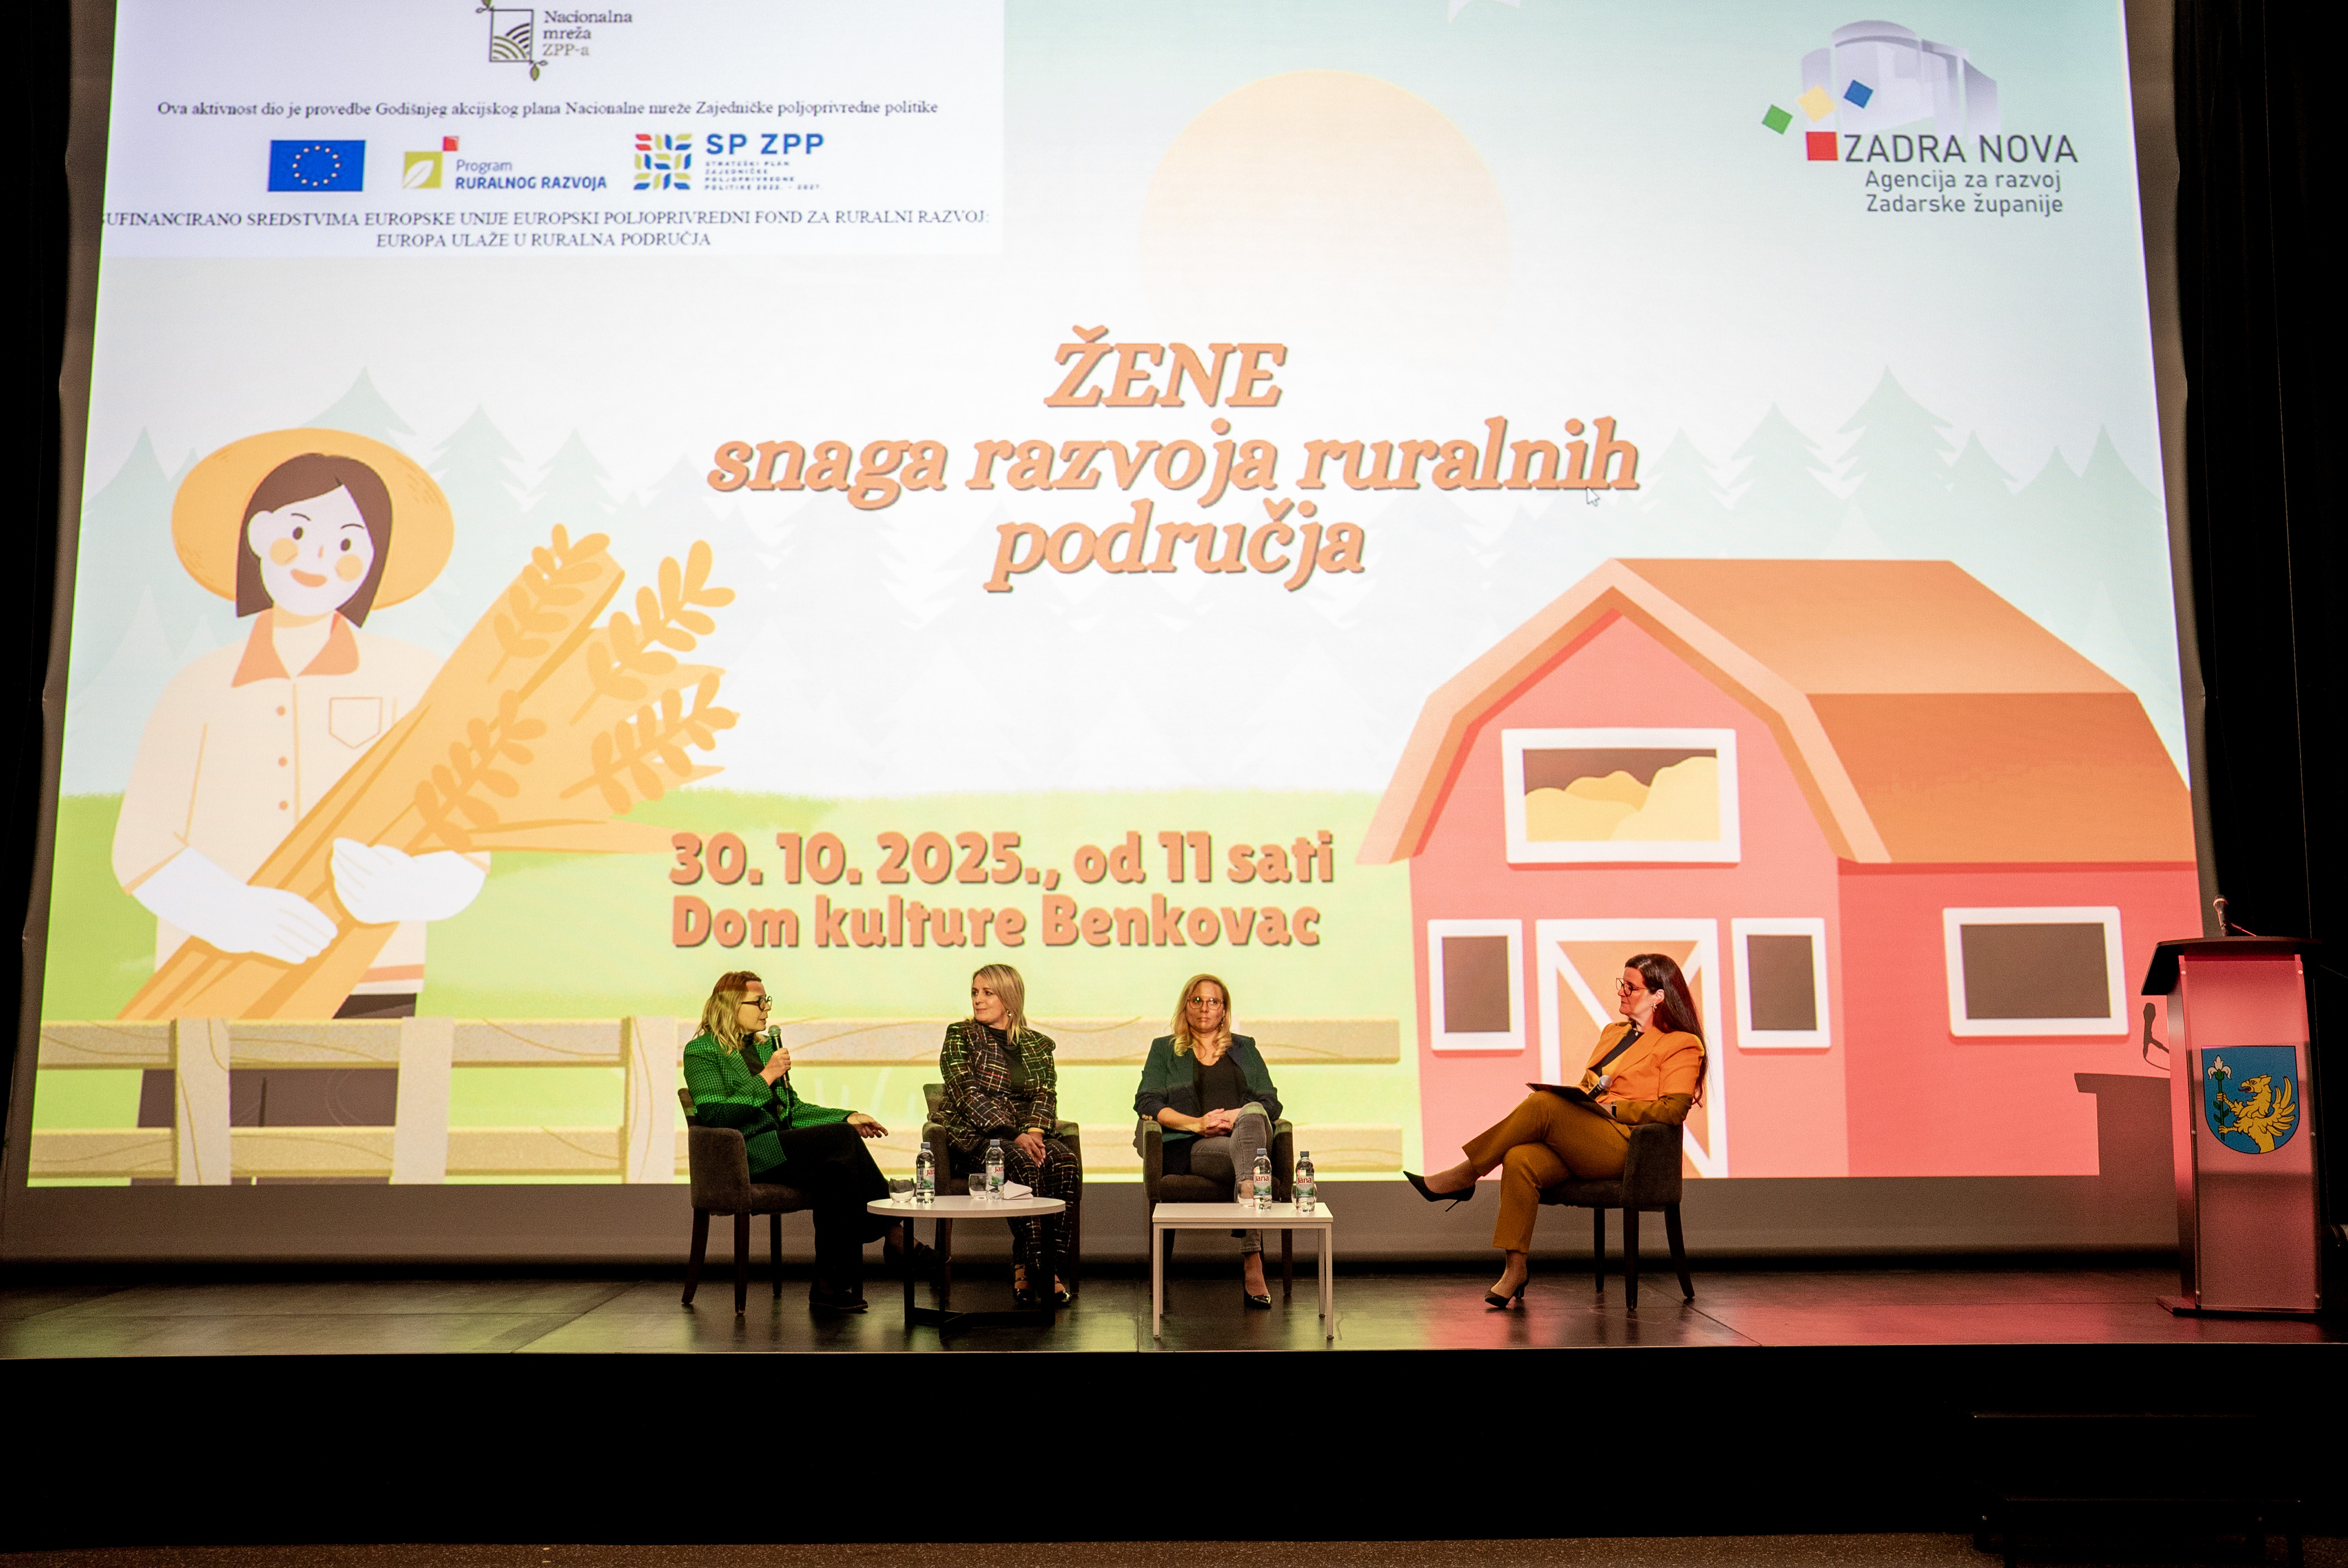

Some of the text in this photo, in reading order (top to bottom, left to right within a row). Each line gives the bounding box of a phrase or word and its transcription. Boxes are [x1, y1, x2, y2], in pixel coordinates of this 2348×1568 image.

[543, 9, 633, 24] Nacionalna
[543, 26, 592, 40] mreža
[542, 43, 590, 57] ZPP-a
[157, 100, 938, 118] Ova aktivnost dio je provedbe Godišnjeg akcijskog plana Nacionalne mreže Zajedničke poljoprivredne politike
[706, 133, 825, 155] SP ZPP
[1844, 133, 2079, 163] ZADRA NOVA
[456, 159, 513, 174] Program
[455, 176, 607, 192] RURALNOG RAZVOJA
[1865, 169, 2062, 192] Agencija za razvoj
[1866, 193, 2064, 217] Zadarske županije
[104, 212, 243, 226] UFINANCIRANO
[246, 212, 361, 227] SREDSTVIMA
[364, 212, 455, 226] EUROPSKE
[460, 212, 508, 225] UNIJE
[513, 212, 600, 225] EUROPSKI
[604, 210, 750, 225] POLJOPRIVREDNI
[755, 210, 803, 224] FOND
[807, 210, 830, 224] ZA
[835, 210, 913, 224] RURALNI
[376, 230, 711, 248] EUROPA ULAŽE U RURALNA PODRUČJA
[1044, 325, 1287, 408] ŽENE
[707, 416, 1639, 510] snaga razvoja ruralnih
[984, 498, 1364, 592] područja
[668, 831, 1333, 890] 30. 10. 2025., od 11 sati
[672, 893, 1321, 948] Dom kulture Benkovac
